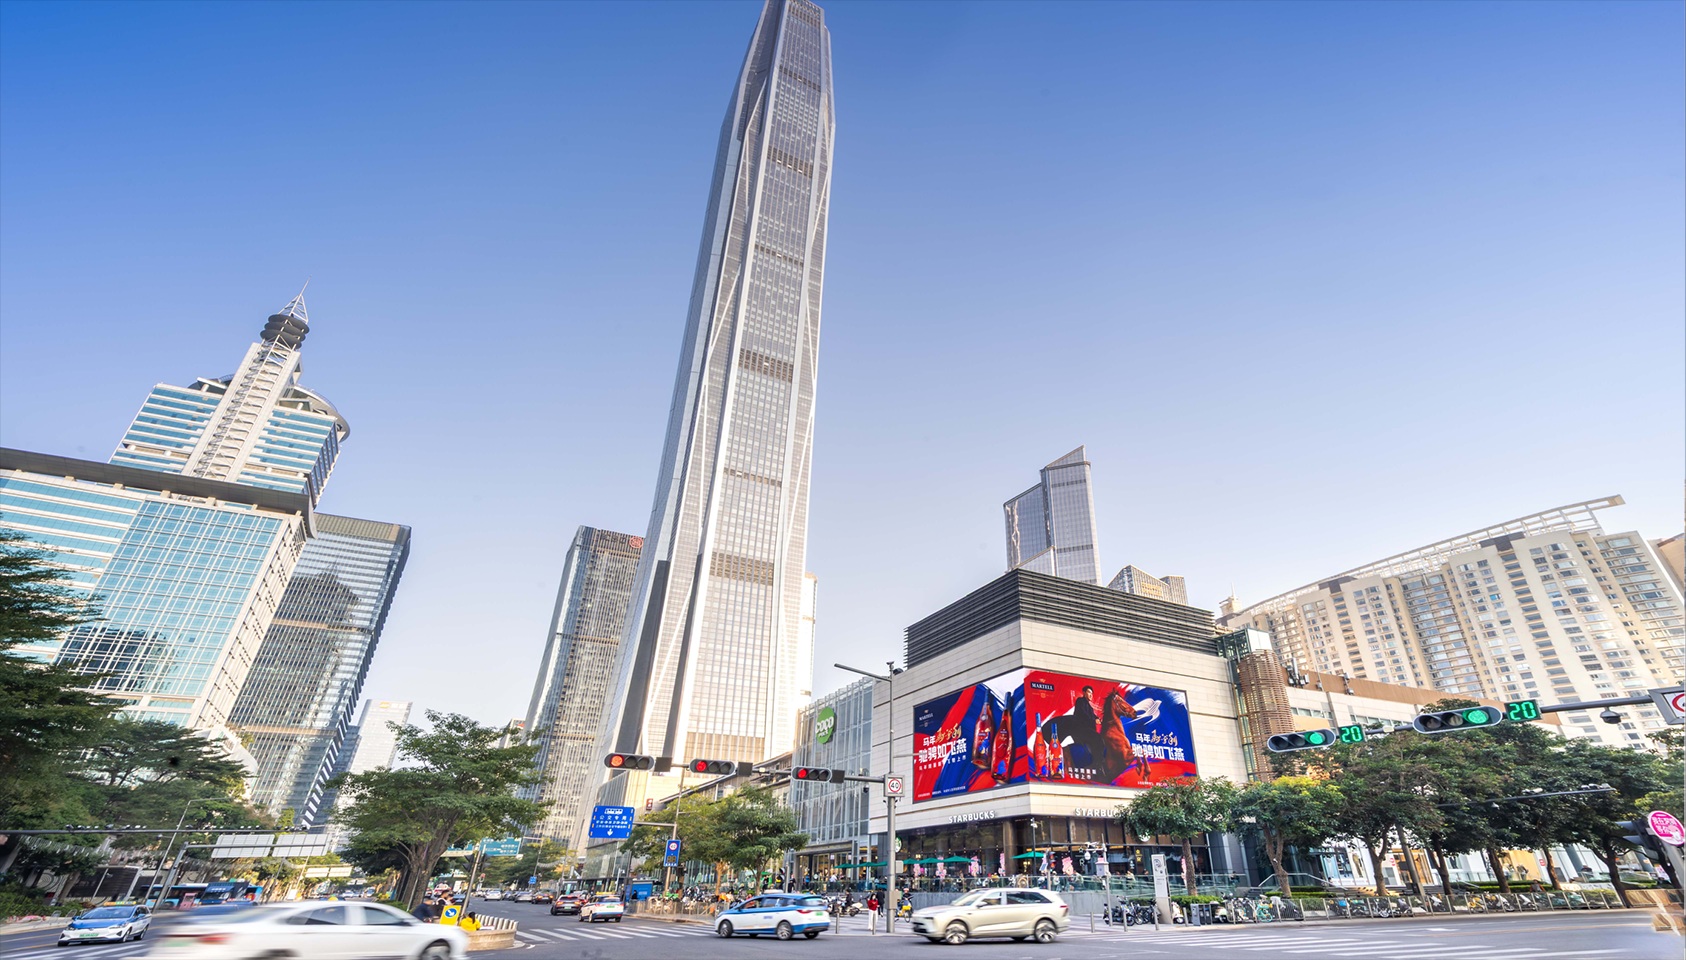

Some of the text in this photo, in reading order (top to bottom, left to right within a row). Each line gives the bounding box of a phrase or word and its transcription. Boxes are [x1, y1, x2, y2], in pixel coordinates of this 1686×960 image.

[1031, 682, 1054, 690] MARTELL
[1509, 701, 1537, 721] 20
[1340, 726, 1364, 743] 20
[948, 810, 995, 824] STARBUCKS
